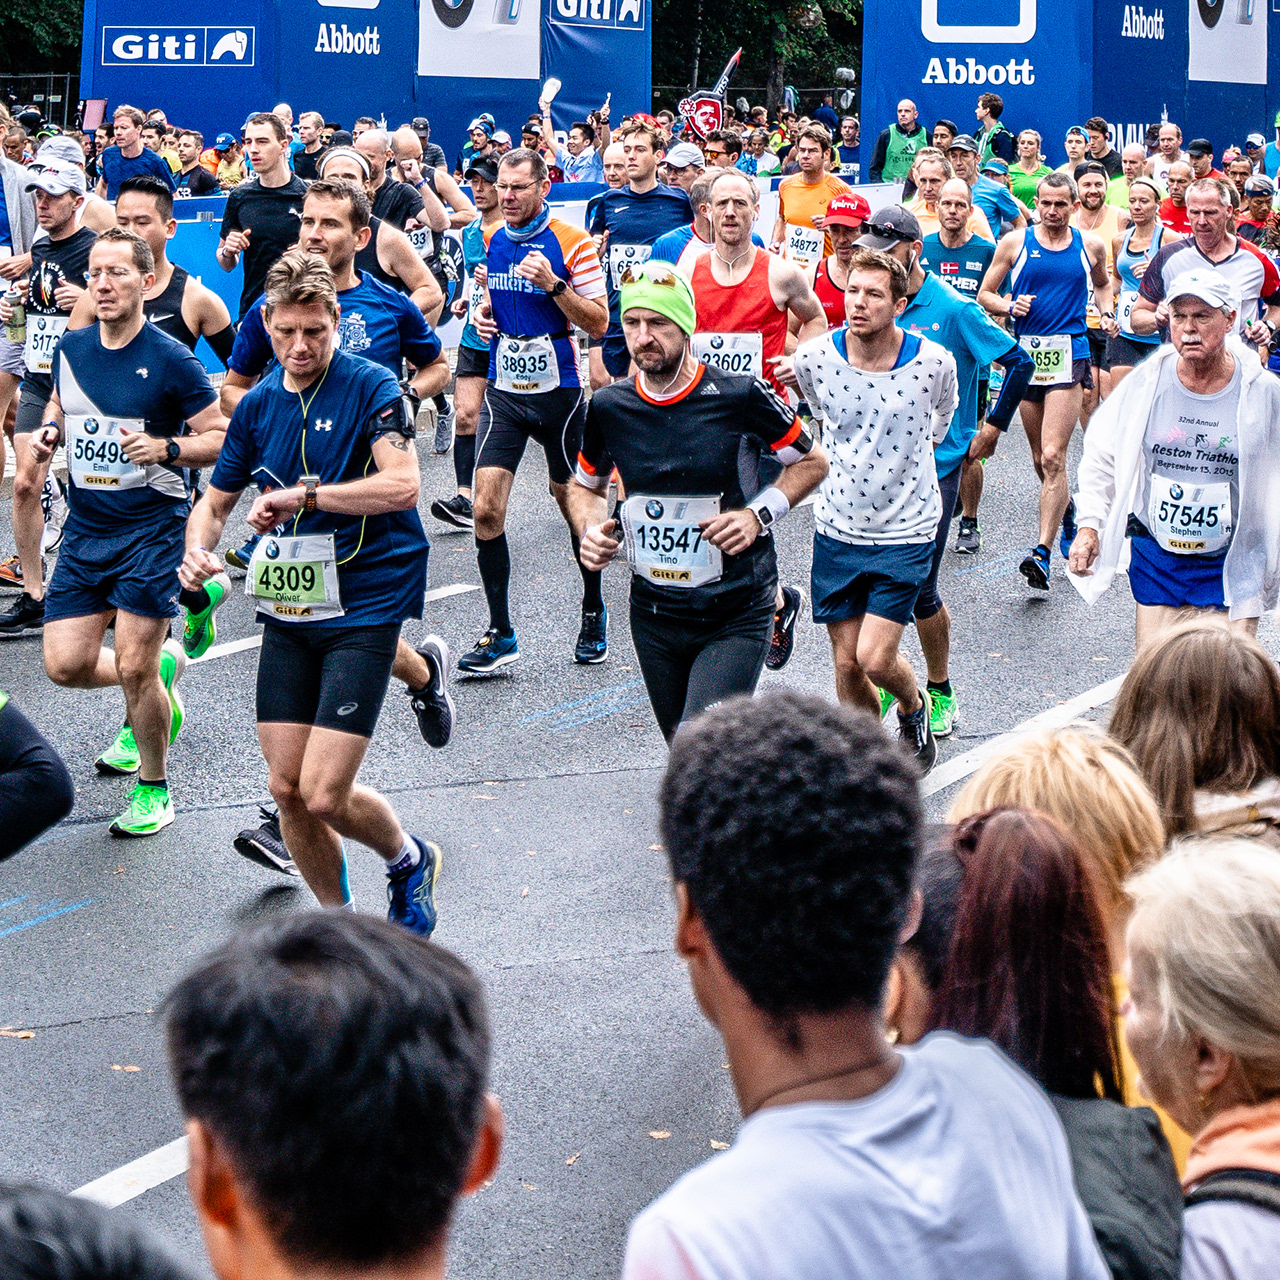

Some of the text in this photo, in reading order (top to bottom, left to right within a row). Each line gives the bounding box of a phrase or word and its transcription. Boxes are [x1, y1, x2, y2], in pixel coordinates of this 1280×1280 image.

[1121, 4, 1165, 41] Abbott
[112, 34, 196, 60] Giti
[314, 23, 381, 55] Abbott
[921, 58, 1036, 86] Abbott
[831, 199, 858, 210] Squirrel
[789, 237, 819, 253] 34872
[502, 354, 548, 374] 38935
[702, 352, 752, 373] 23602
[1177, 416, 1220, 428] 32nd Annual
[1151, 443, 1240, 466] Reston Triathlo
[93, 463, 110, 473] Emil
[1156, 459, 1234, 477] September 2015
[85, 476, 108, 486] Giti
[1158, 501, 1219, 528] 57545
[636, 524, 705, 554] 13547
[1170, 526, 1203, 537] Stephen
[1169, 540, 1193, 549] Giti
[658, 553, 678, 565] Tino
[258, 564, 316, 593] 4309
[651, 570, 676, 581] Giti
[275, 592, 301, 603] Oliver
[275, 606, 298, 616] Giti
